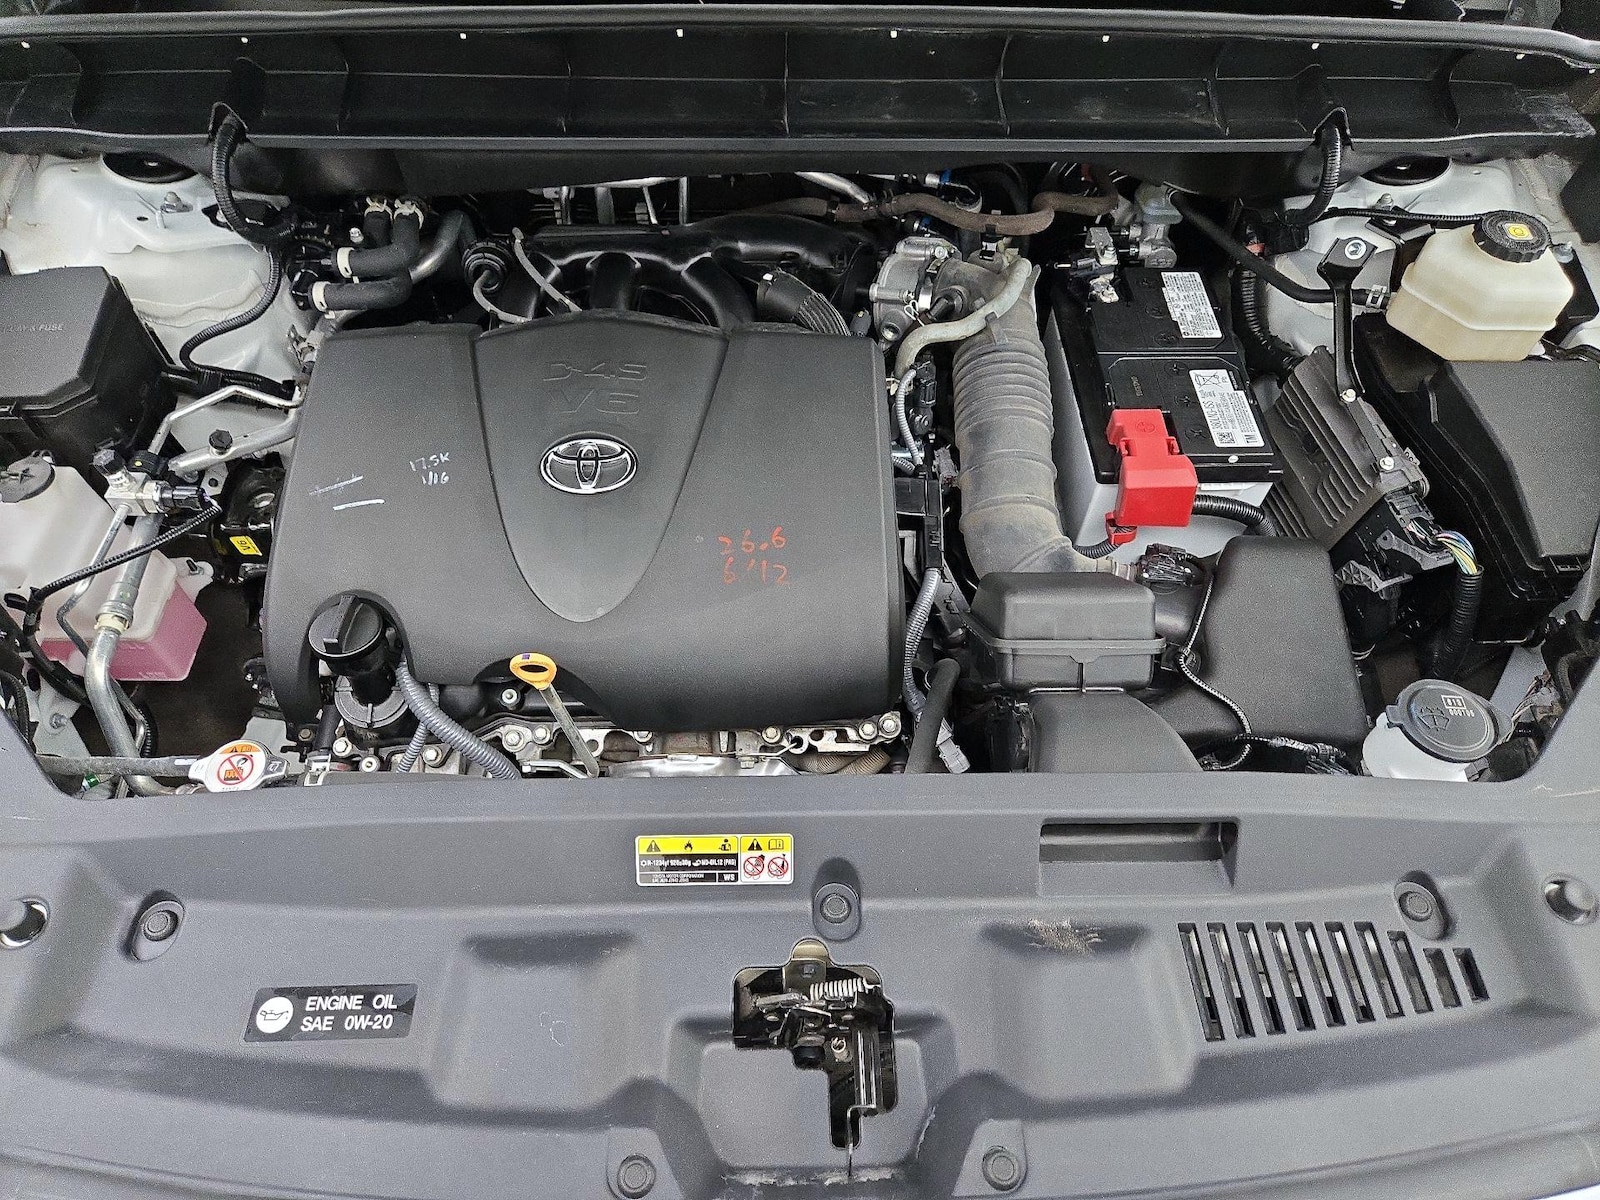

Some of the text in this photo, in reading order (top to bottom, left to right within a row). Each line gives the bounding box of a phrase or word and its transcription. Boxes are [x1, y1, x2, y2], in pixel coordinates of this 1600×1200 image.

[723, 873, 736, 882] WS
[305, 994, 398, 1011] ENGINE OIL
[300, 1014, 393, 1032] SAE 0W-20
